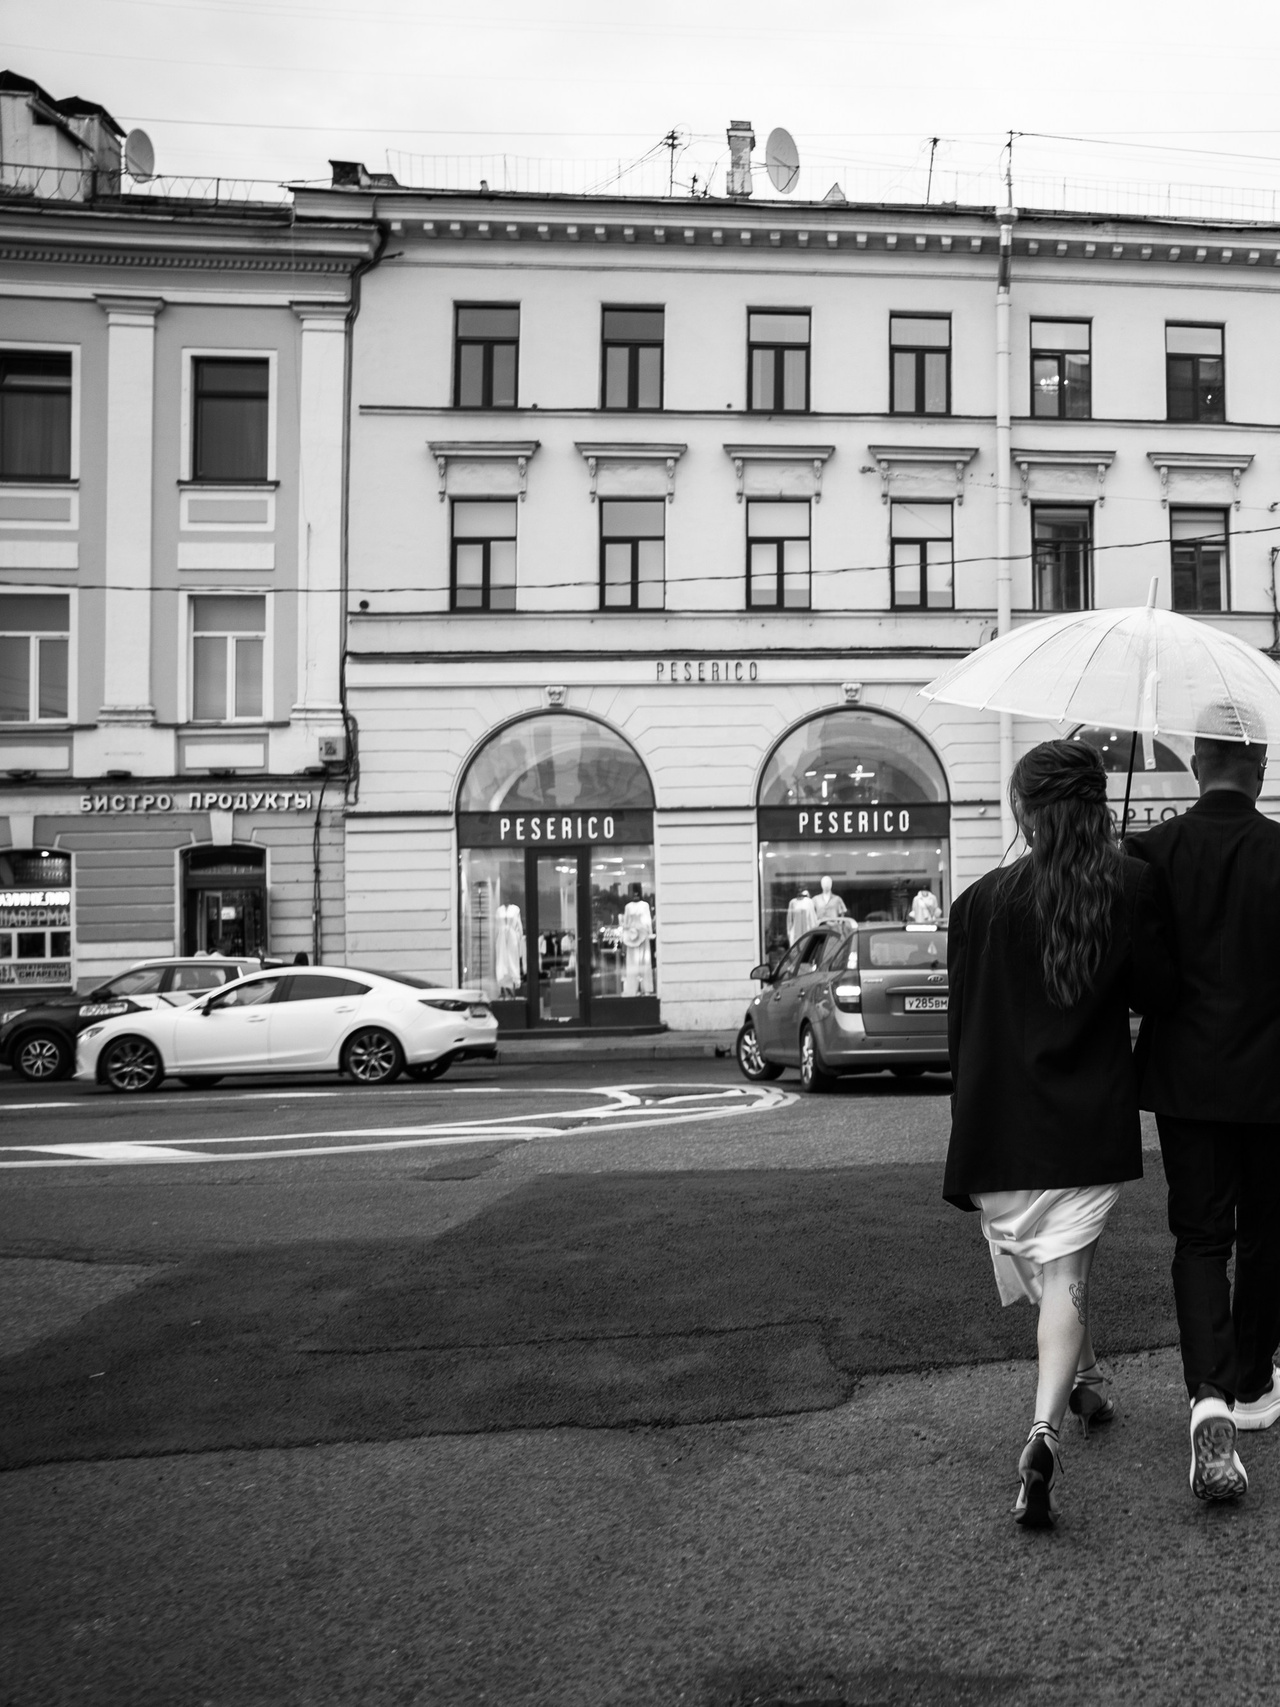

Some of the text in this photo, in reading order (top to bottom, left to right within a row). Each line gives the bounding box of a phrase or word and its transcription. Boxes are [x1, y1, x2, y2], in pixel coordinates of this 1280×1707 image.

[656, 661, 758, 682] PESERICO
[80, 792, 312, 812] БИСТРО ПРОДУКТЫ
[500, 816, 615, 841] PESERICO
[798, 810, 910, 834] PESERICO
